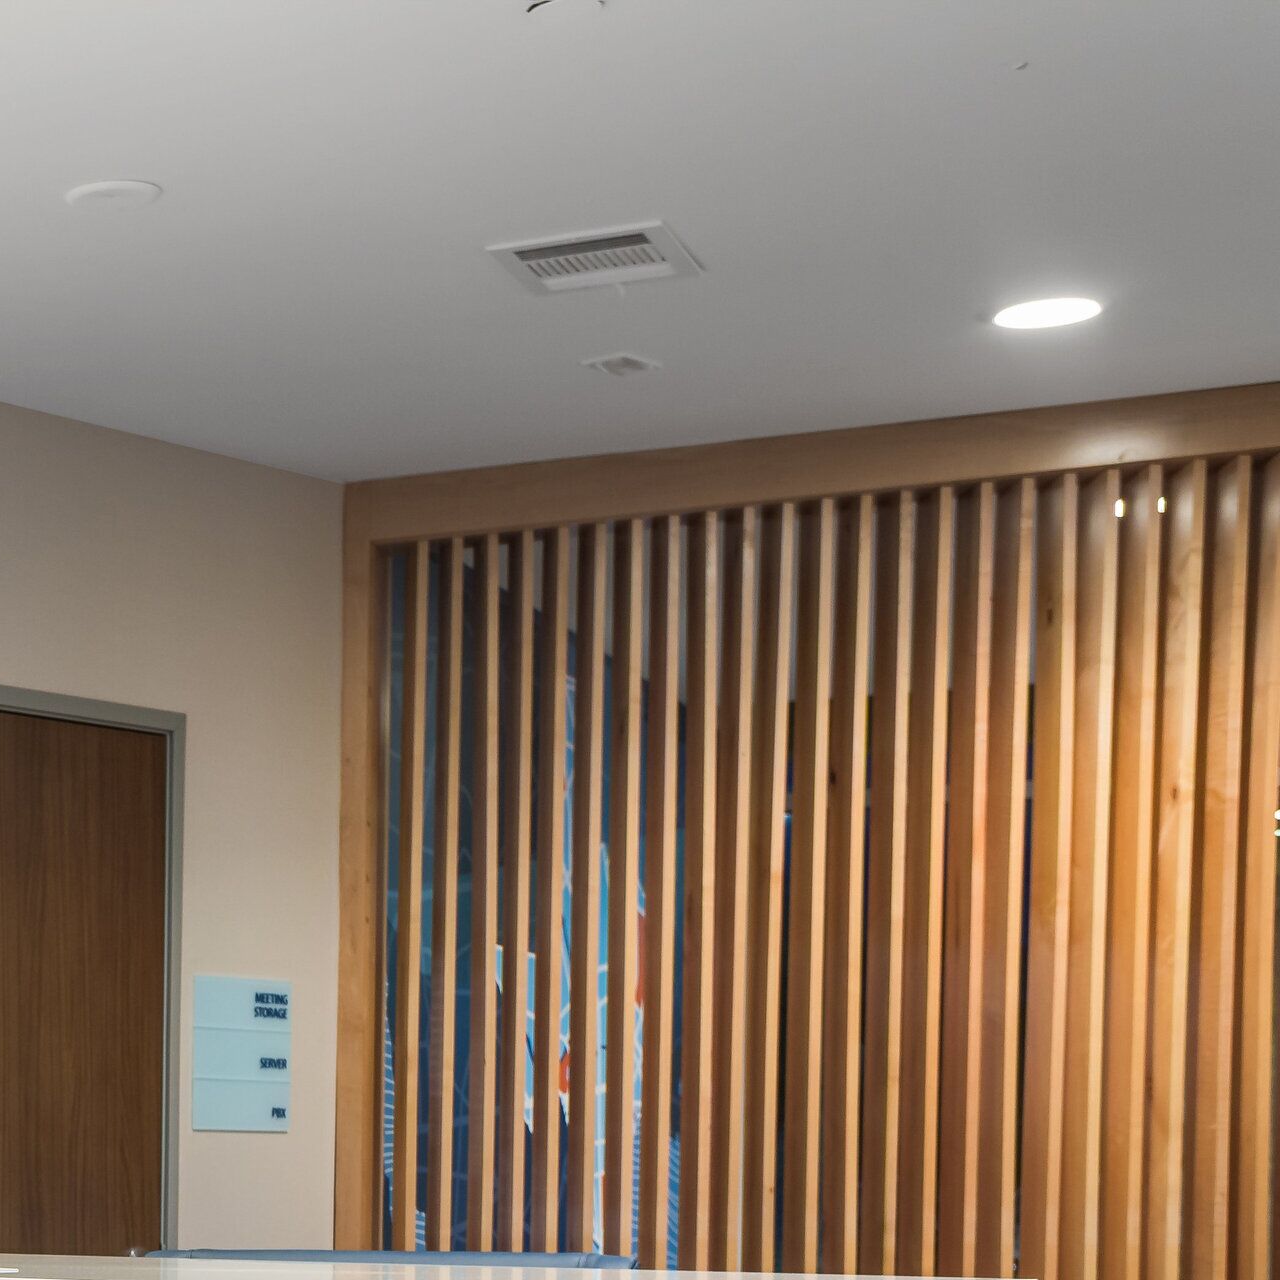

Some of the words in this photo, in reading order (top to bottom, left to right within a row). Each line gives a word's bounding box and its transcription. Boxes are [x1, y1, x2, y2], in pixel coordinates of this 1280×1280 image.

[254, 992, 288, 1005] MEETING
[254, 1006, 287, 1019] STORAGE
[260, 1057, 287, 1069] SERVER
[271, 1107, 286, 1119] PBX
